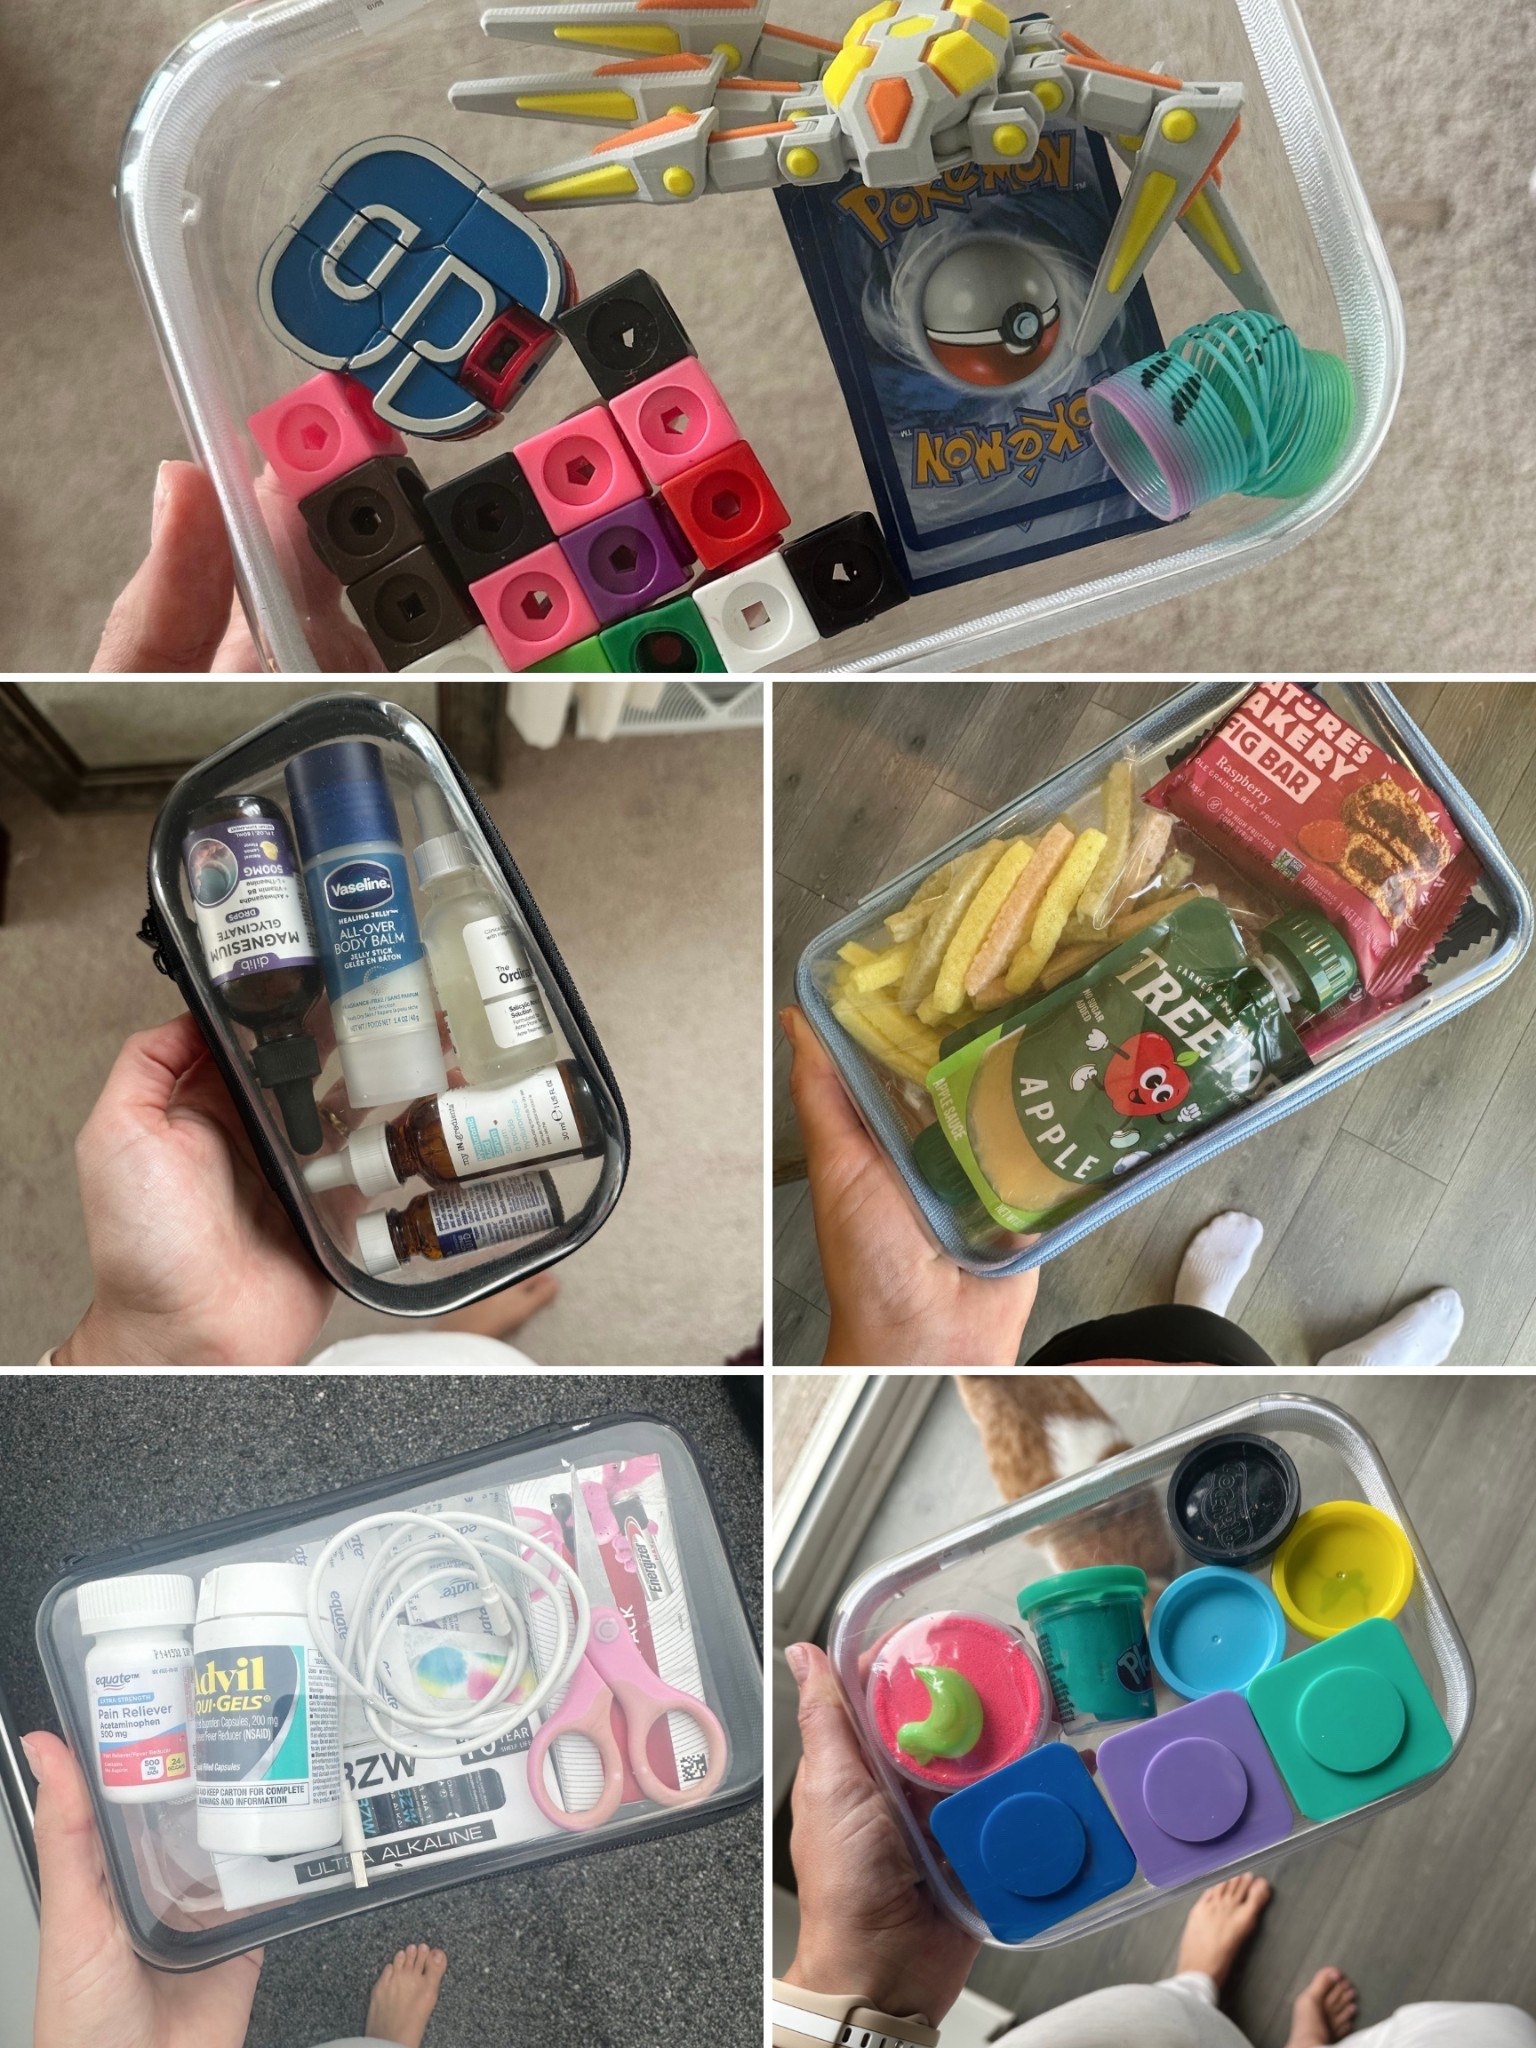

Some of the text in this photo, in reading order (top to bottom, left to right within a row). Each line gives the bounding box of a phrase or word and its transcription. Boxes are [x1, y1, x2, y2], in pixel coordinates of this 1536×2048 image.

[1225, 717, 1309, 796] FIG BAR
[1216, 756, 1271, 805] Raspberry
[1208, 770, 1236, 793] GRAINS
[1239, 794, 1260, 813] REAL
[1259, 808, 1281, 829] FRUIT
[1217, 812, 1254, 844] CORN SYRUP
[1232, 814, 1247, 828] HIGH
[1245, 824, 1276, 851] FRUCTOSE
[244, 864, 283, 877] 500MG
[1300, 872, 1318, 890] 200
[240, 894, 284, 904] Ashwagandha
[229, 910, 256, 920] DROPS
[339, 915, 369, 924] HEALING
[217, 919, 281, 941] GLYCINATE
[340, 921, 395, 939] ALL-OVER
[211, 931, 300, 962] MAGNESIUM
[335, 932, 405, 955] BODY BALM
[345, 959, 364, 969] GELÉE
[379, 953, 401, 962] BÂTON
[350, 948, 392, 960] JELLY STICK
[499, 969, 531, 983] Ordina
[509, 1003, 530, 1012] Salicylic
[1075, 999, 1092, 1022] ADDED
[1083, 988, 1105, 1023] NO SUGAR
[1115, 947, 1214, 1059] TREE
[511, 1008, 532, 1018] Solution
[933, 1077, 967, 1142] APPLE SAUCE
[558, 1121, 566, 1131] ml
[1019, 1077, 1100, 1180] APPLE
[561, 1130, 569, 1140] 30
[461, 1153, 469, 1165] my
[634, 1540, 664, 1594] Energizer
[329, 1590, 348, 1641] equate
[117, 1694, 151, 1703] STRENGTH
[98, 1704, 172, 1720] Pain Reliever
[100, 1717, 160, 1729] Acetaminophen
[220, 1715, 250, 1727] Capsules,
[251, 1715, 265, 1725] 200
[266, 1715, 278, 1727] mg
[100, 1730, 127, 1739] 500 mg
[219, 1728, 271, 1741] Reducer (NSAID)
[519, 1739, 531, 1747] LIFE
[214, 1762, 240, 1771] Capsules
[220, 1788, 246, 1796] CARTON
[249, 1787, 263, 1795] FOR
[266, 1785, 304, 1794] COMPLETE
[220, 1797, 233, 1805] AND
[235, 1795, 287, 1805] INFORMATION
[382, 1826, 483, 1858] ALKALINE
